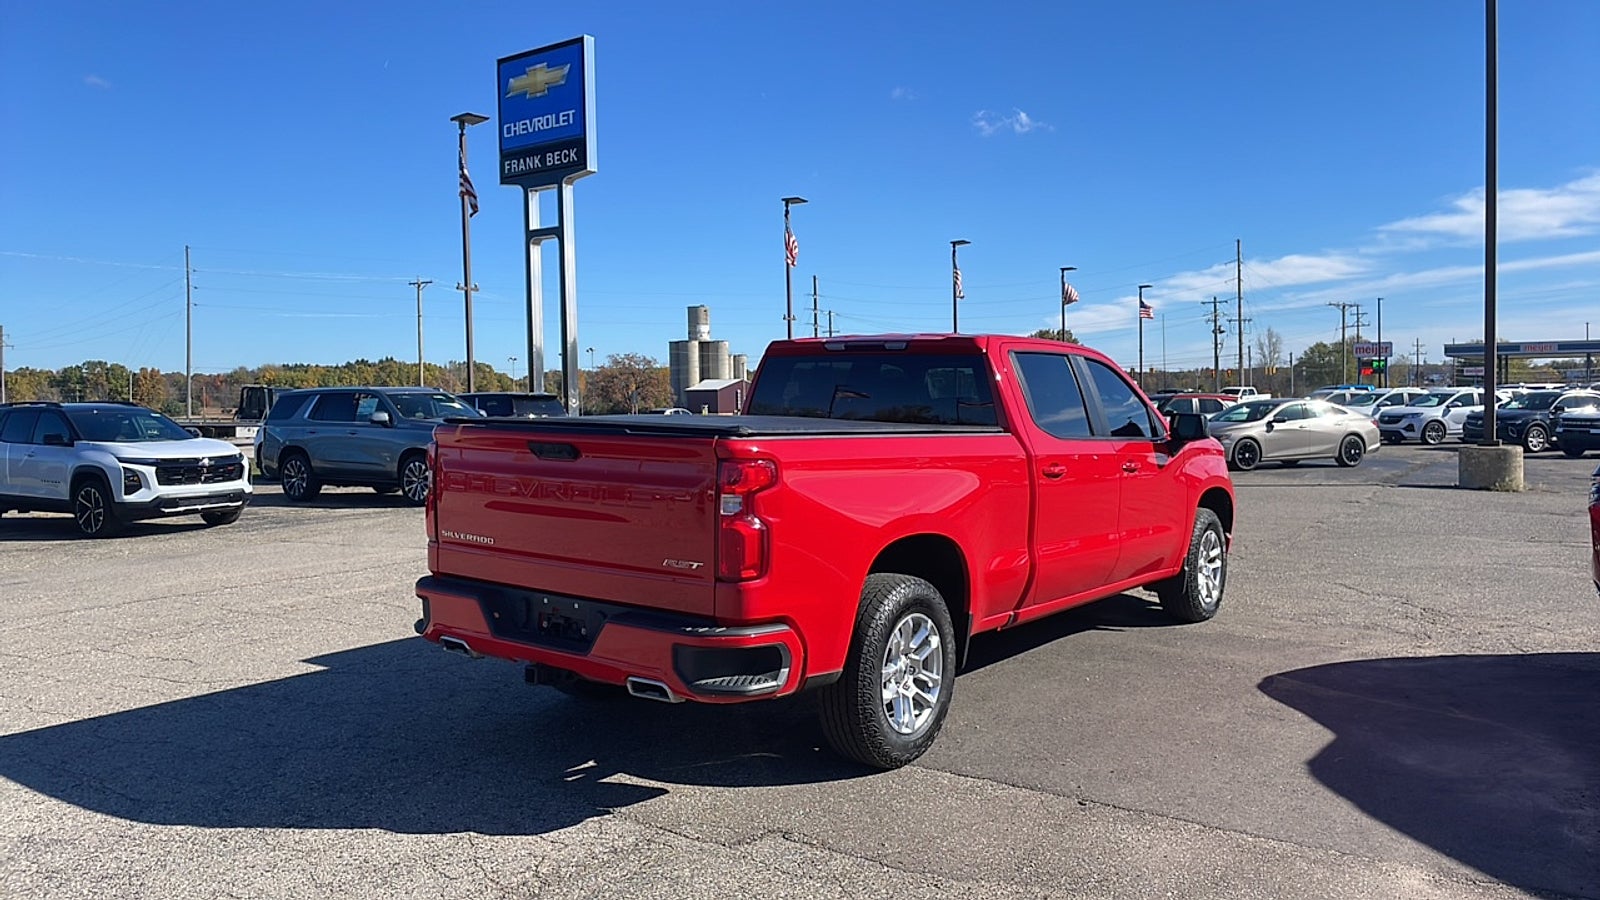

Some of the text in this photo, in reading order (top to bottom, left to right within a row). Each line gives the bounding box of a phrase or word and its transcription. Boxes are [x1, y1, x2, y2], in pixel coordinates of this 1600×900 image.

[503, 109, 576, 138] CHEVROLET
[504, 147, 578, 174] FRANK BECK
[441, 530, 494, 545] SILVERADO
[662, 559, 704, 569] RST
